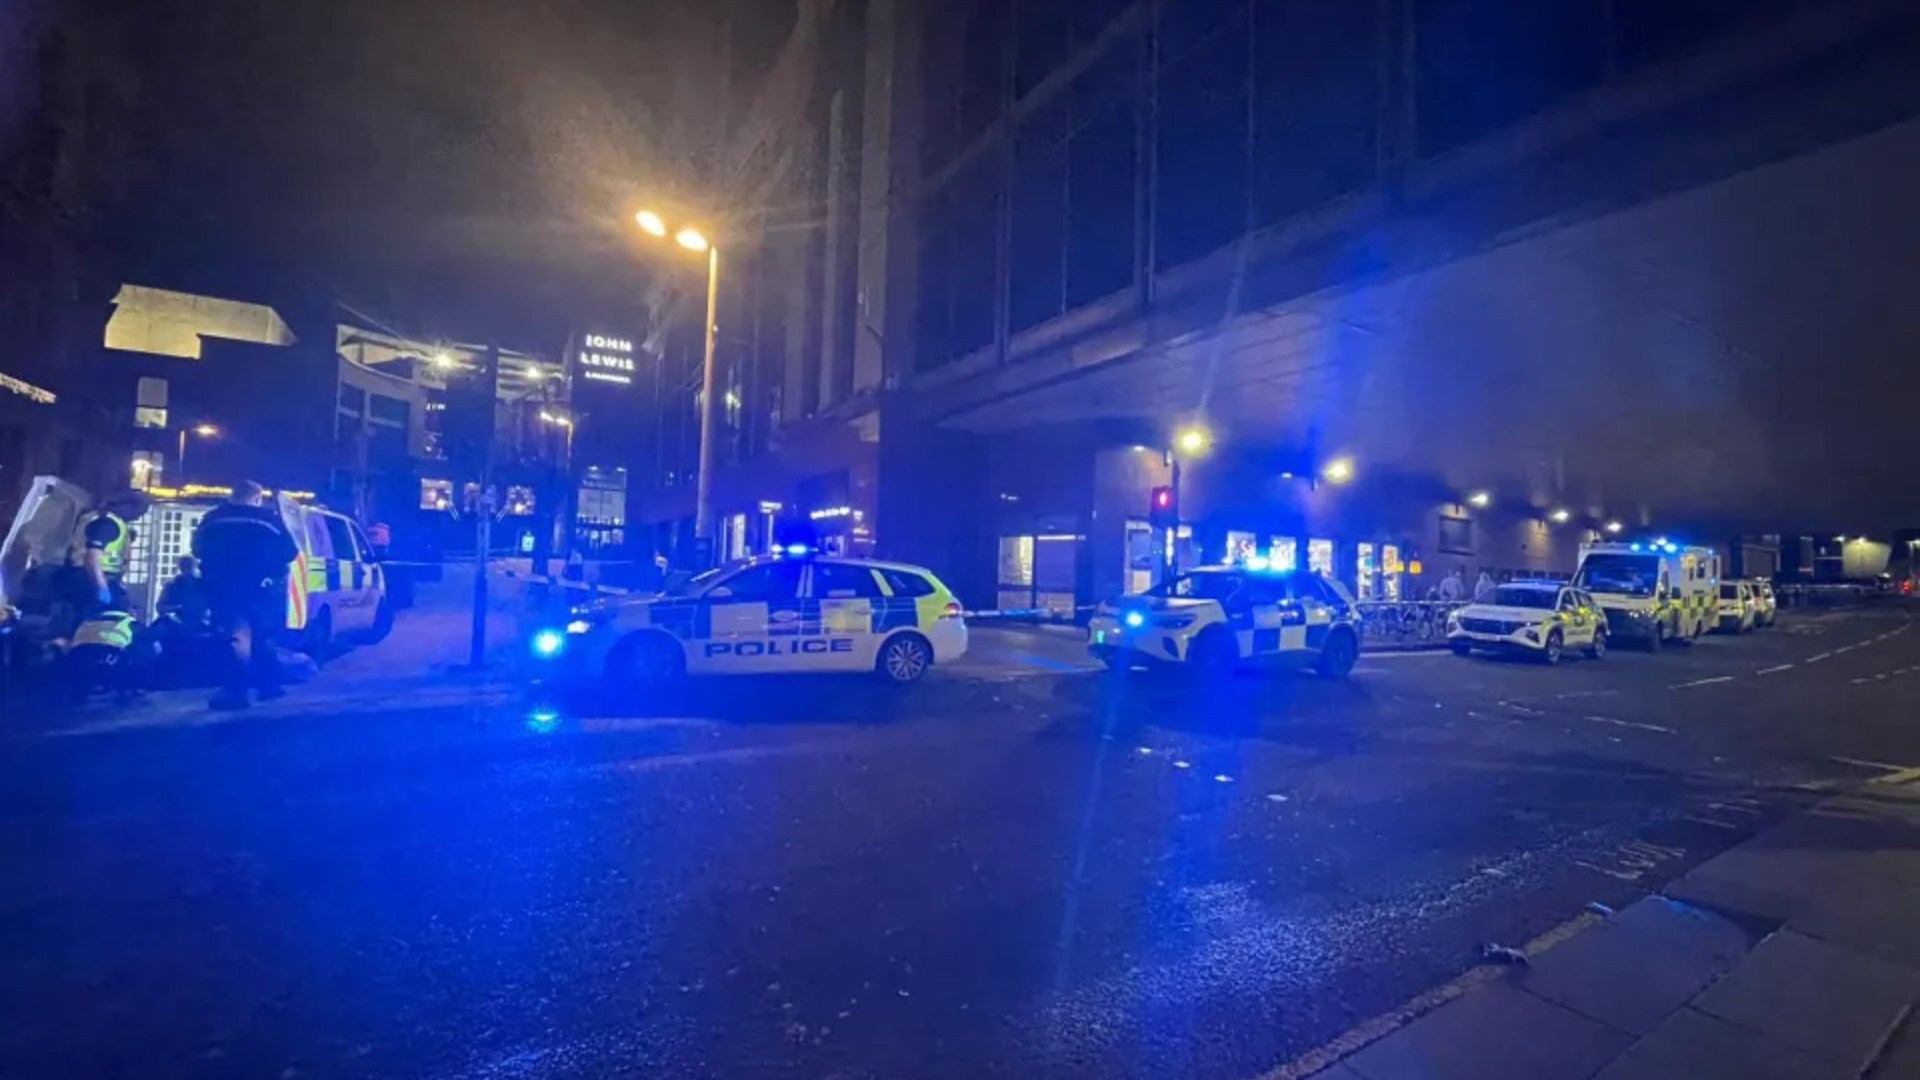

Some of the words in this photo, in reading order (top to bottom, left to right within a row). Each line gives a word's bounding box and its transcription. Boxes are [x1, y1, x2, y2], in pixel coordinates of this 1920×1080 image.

[585, 334, 632, 352] JOHN
[580, 352, 634, 370] LEWIS
[704, 638, 854, 658] POLICE
